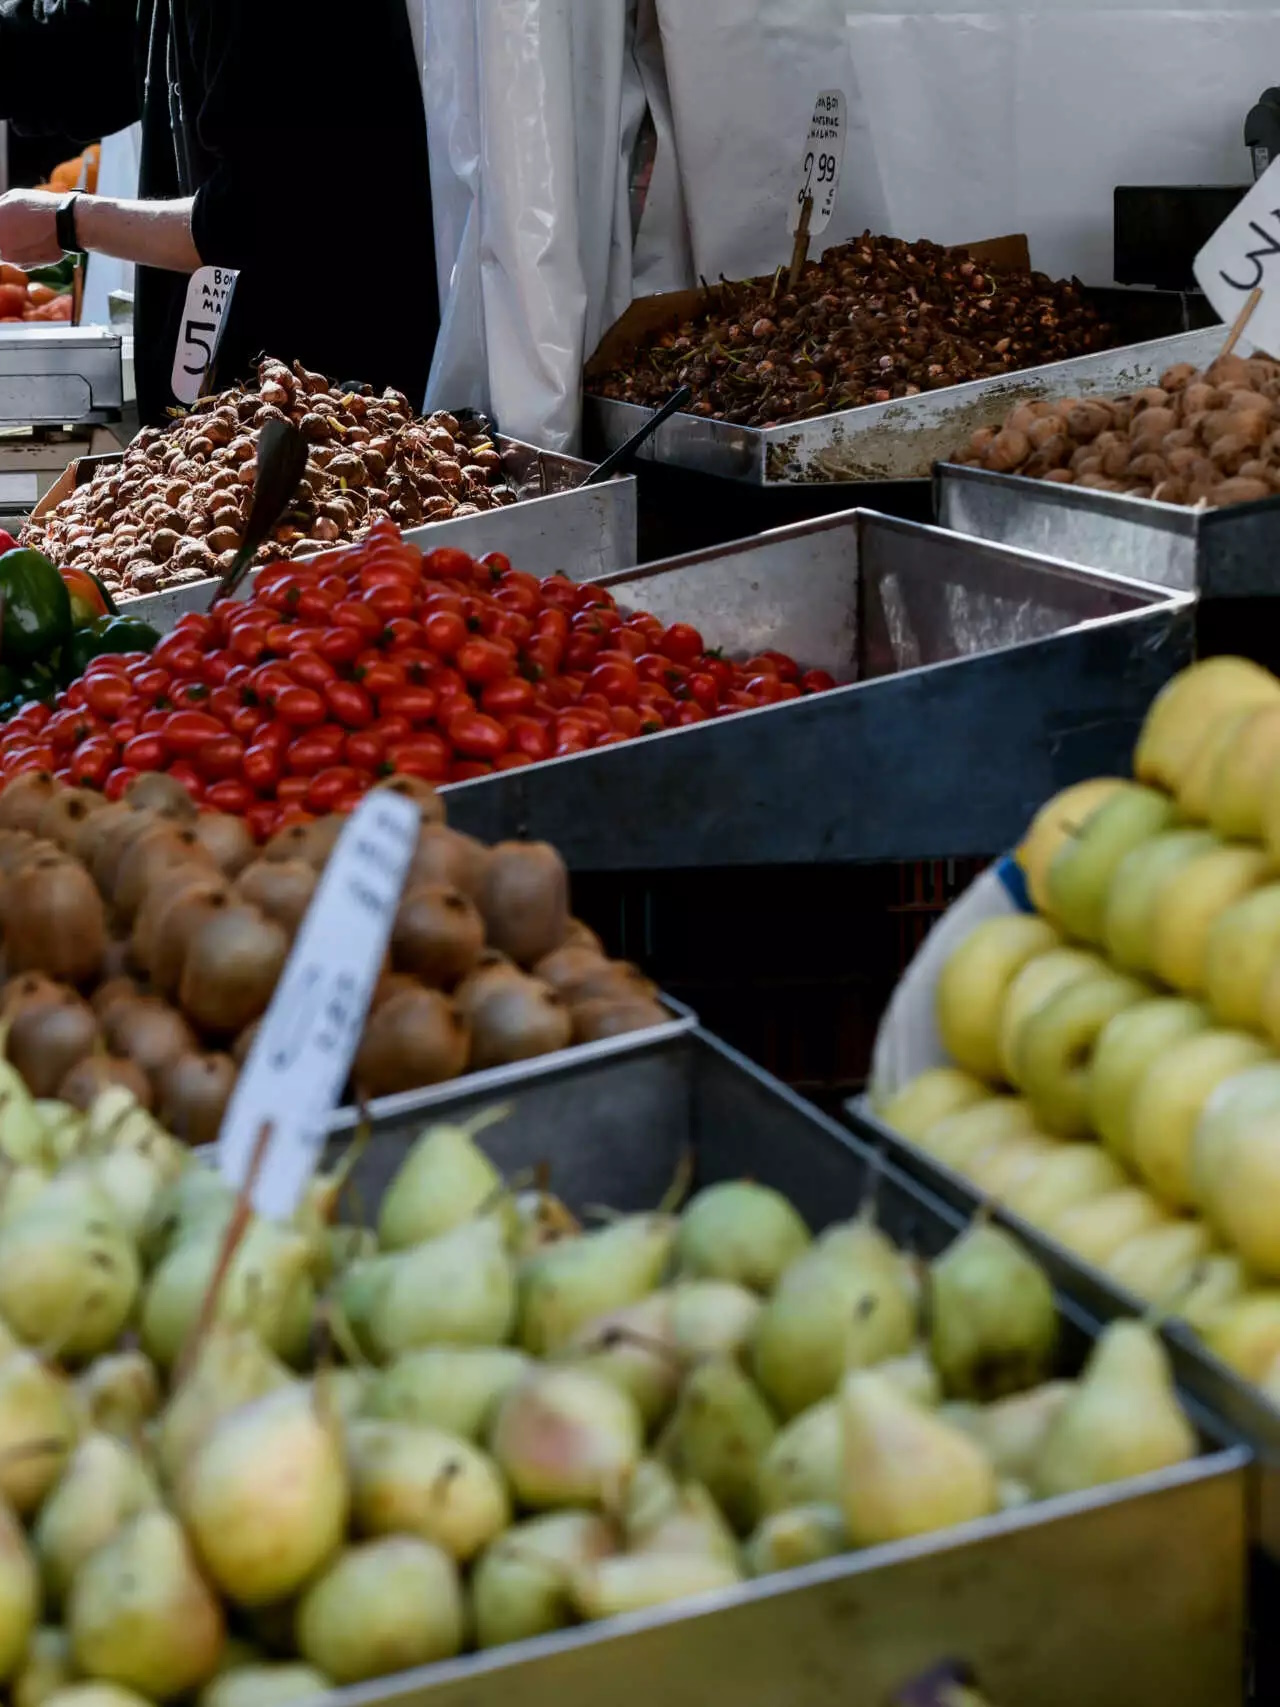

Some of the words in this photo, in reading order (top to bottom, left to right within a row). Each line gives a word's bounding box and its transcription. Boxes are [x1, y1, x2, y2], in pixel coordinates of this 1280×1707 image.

[817, 153, 836, 182] 99
[1219, 221, 1280, 290] 3
[183, 320, 216, 375] 5
